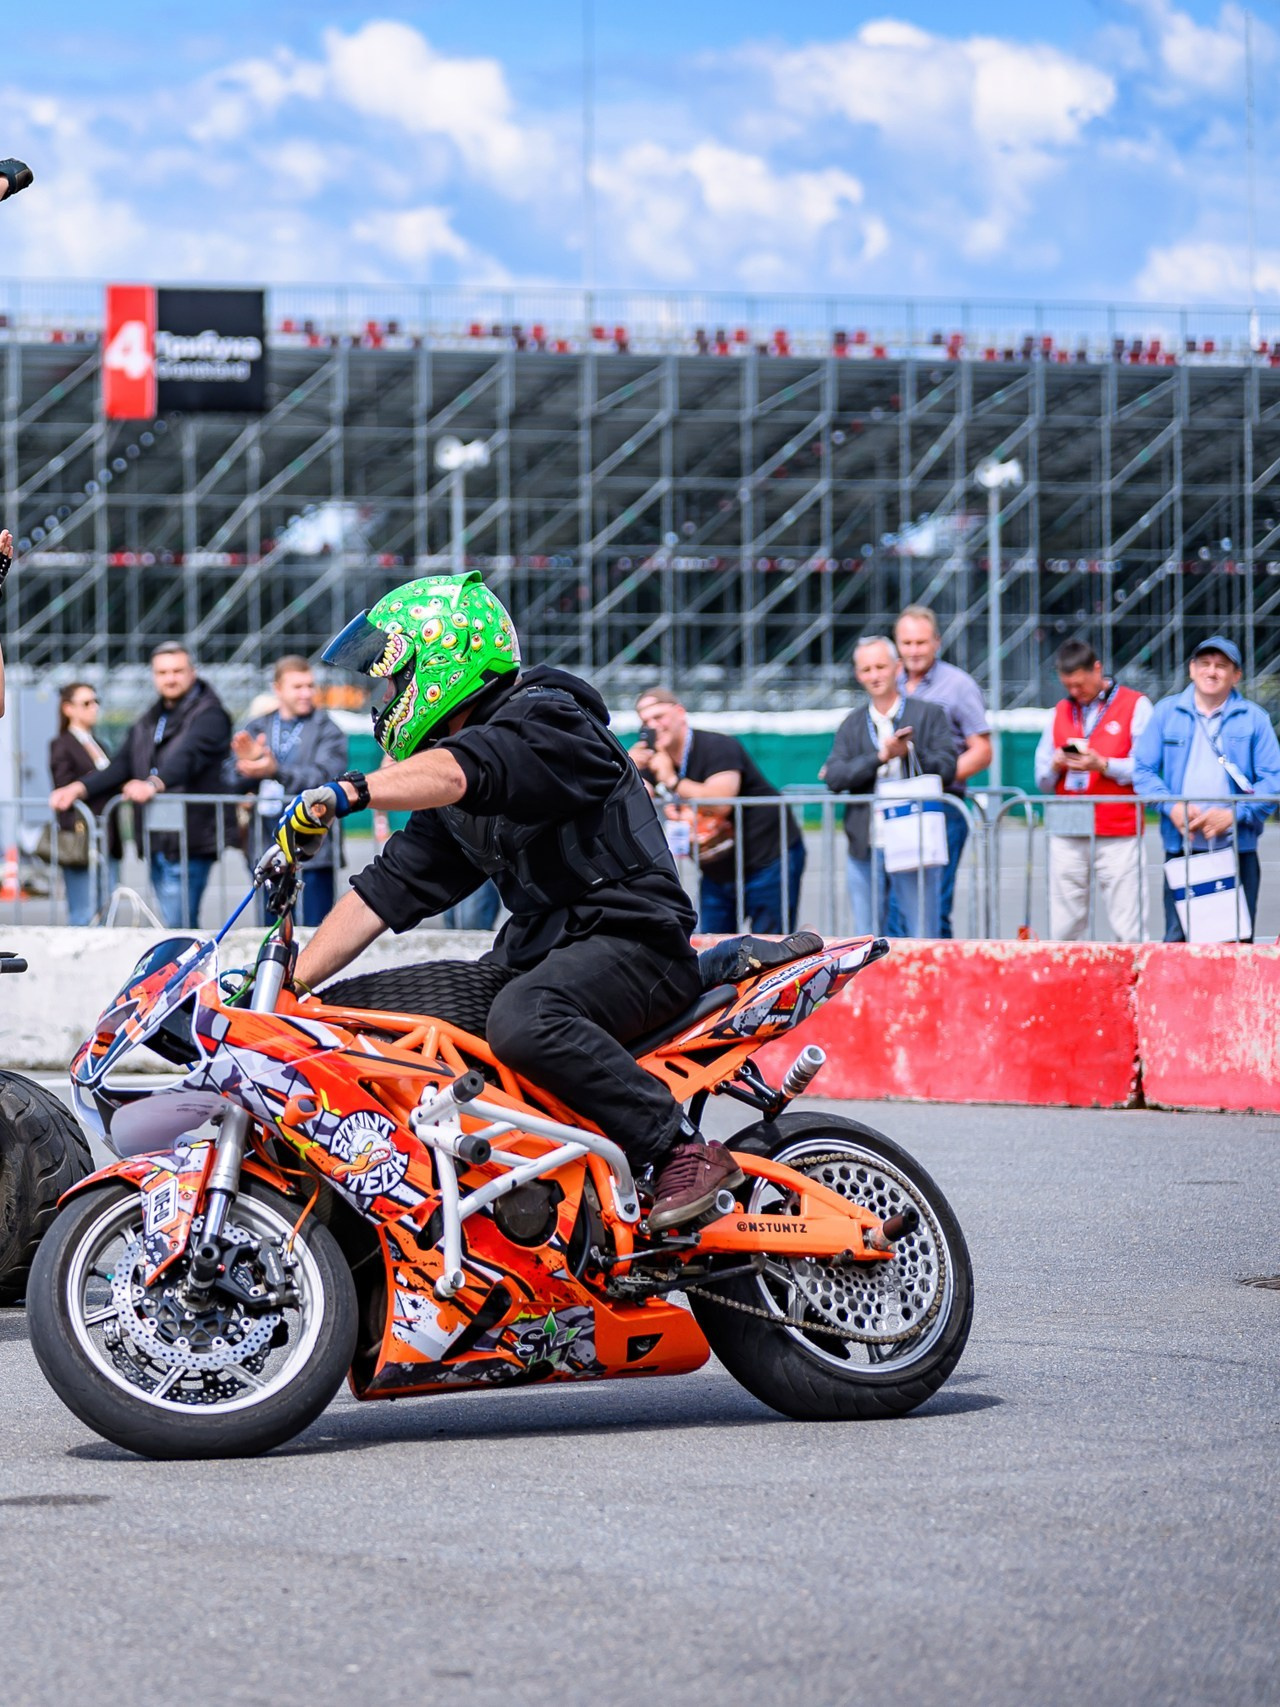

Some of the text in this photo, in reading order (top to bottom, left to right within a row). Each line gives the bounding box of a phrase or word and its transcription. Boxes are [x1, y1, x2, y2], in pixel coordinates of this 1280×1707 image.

[105, 320, 152, 379] 4
[330, 1111, 397, 1160] STUNT
[346, 1151, 408, 1194] TECH
[737, 1221, 807, 1233] @NSTUNTZ
